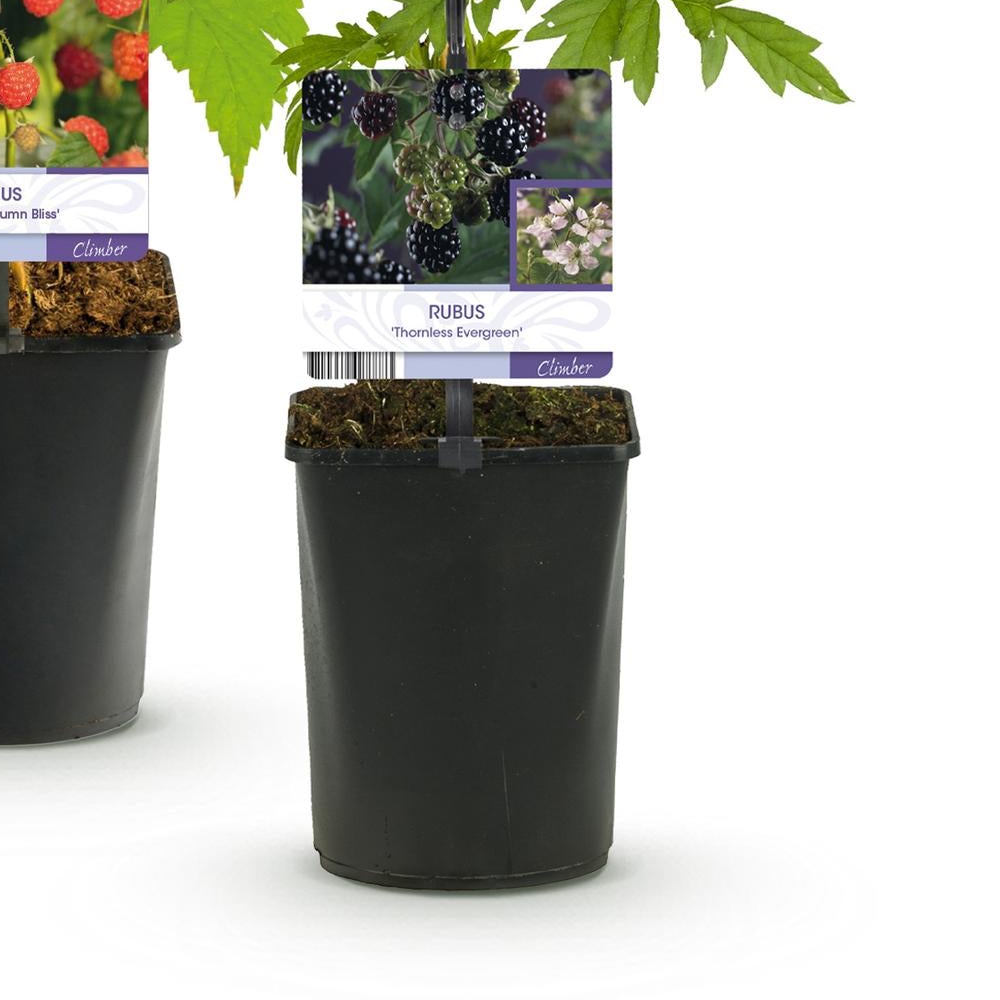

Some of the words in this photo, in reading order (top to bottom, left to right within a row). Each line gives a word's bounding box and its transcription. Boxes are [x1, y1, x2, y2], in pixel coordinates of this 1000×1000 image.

[31, 208, 60, 220] Bliss'
[72, 238, 128, 258] Climber
[429, 304, 485, 320] RUBUS
[391, 326, 453, 338] 'Thornless
[456, 326, 523, 341] Evergreen'
[537, 356, 593, 377] Climber
